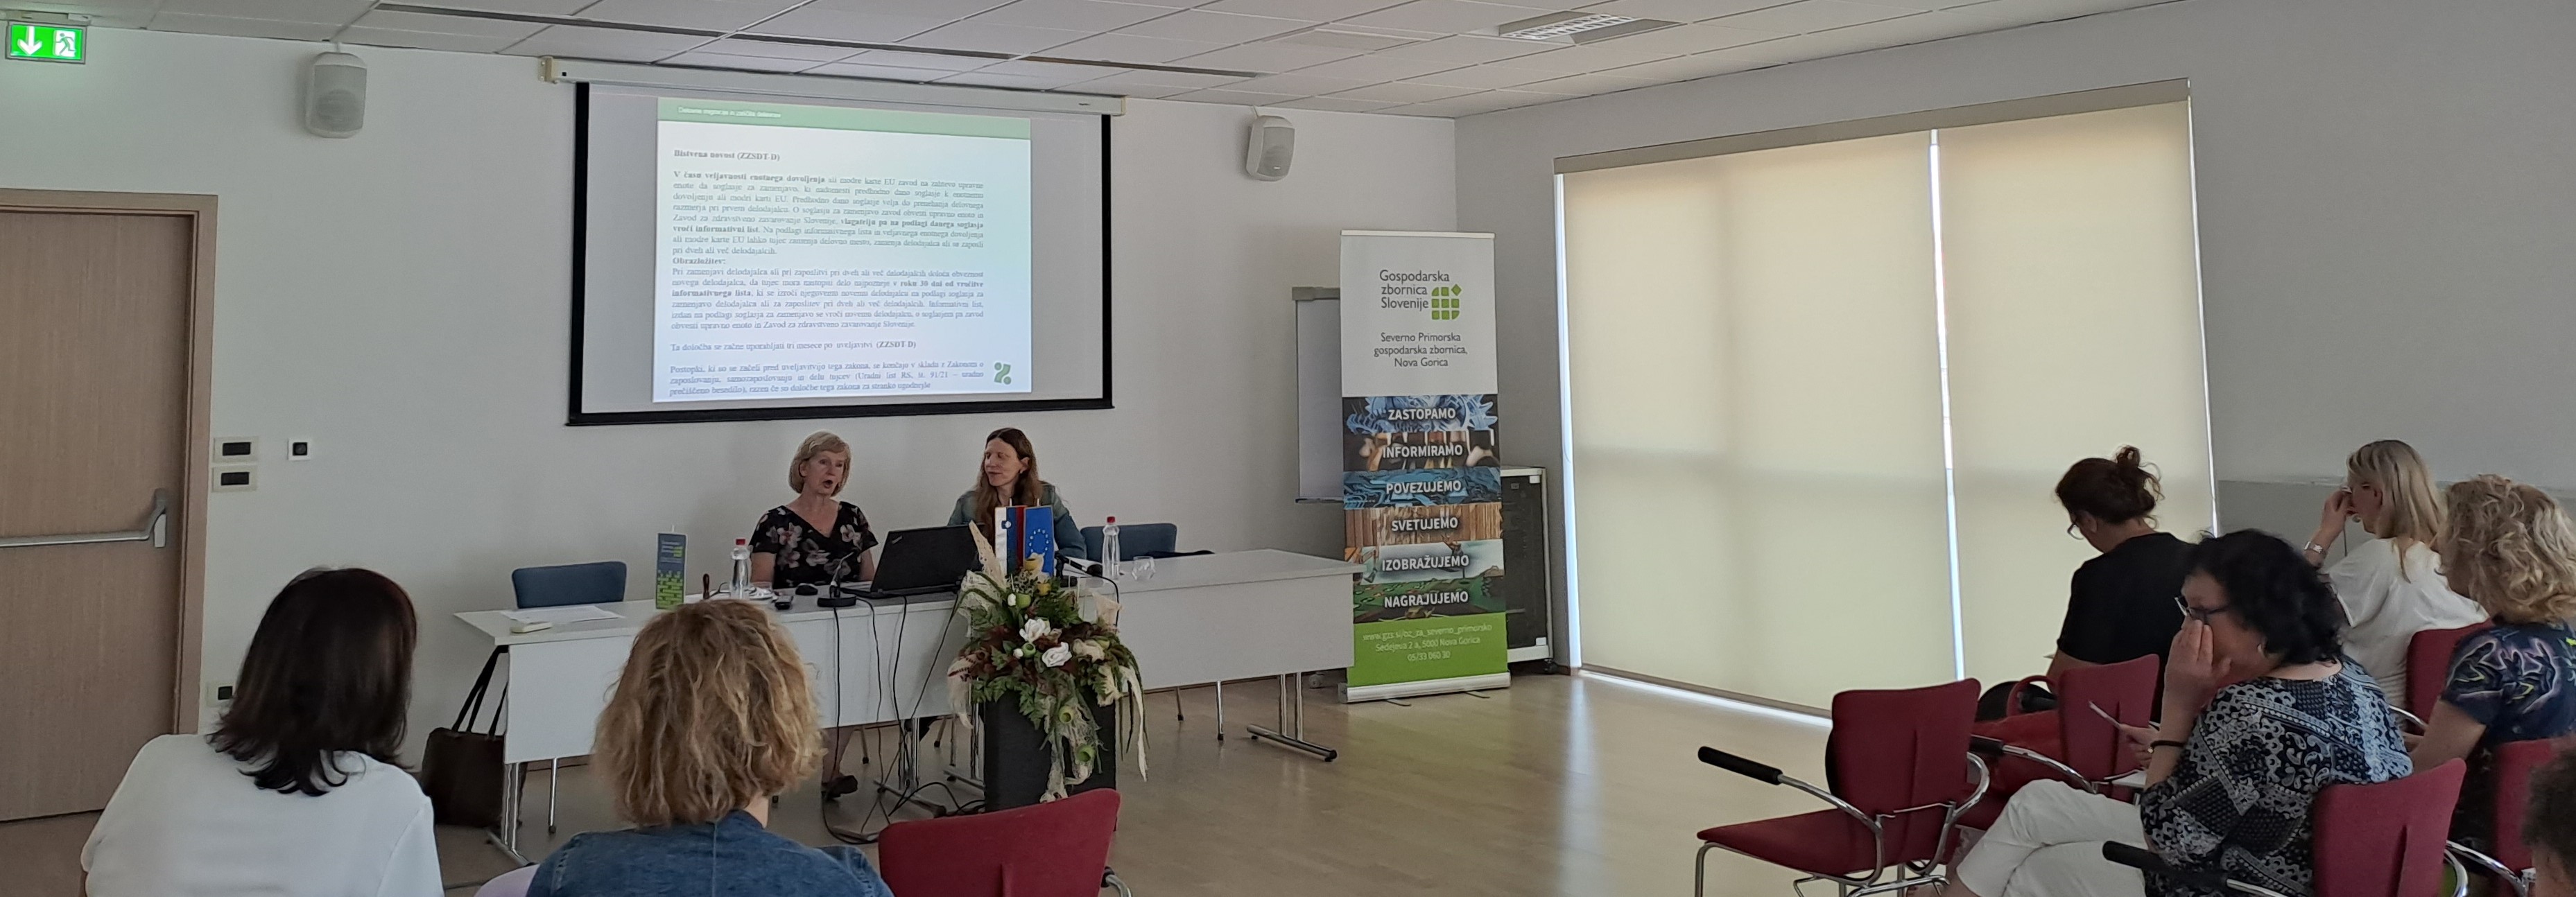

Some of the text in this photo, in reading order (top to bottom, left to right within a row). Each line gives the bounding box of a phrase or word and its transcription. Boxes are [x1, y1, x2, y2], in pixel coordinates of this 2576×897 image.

[1379, 269, 1450, 284] Gospodarska
[1381, 284, 1428, 295] zbornica
[1381, 297, 1429, 311] Slovenije
[1381, 332, 1461, 342] Severno Primorska
[1374, 345, 1468, 357] gospodarska zbornica,
[1394, 357, 1449, 367] Nova Gorica
[1388, 408, 1456, 421] ZASTOPAMO
[1383, 444, 1463, 458] INFORMIRAMO
[1387, 480, 1462, 494] POVEZUJEMO
[1392, 517, 1458, 532] SVETUJEMO
[1382, 555, 1469, 571] IZOBRAŽUJEMO
[1384, 591, 1469, 608] NAGRAJUJEMO
[1408, 641, 1413, 650] 2
[1440, 638, 1458, 647] Nova
[1458, 636, 1481, 645] Gorica
